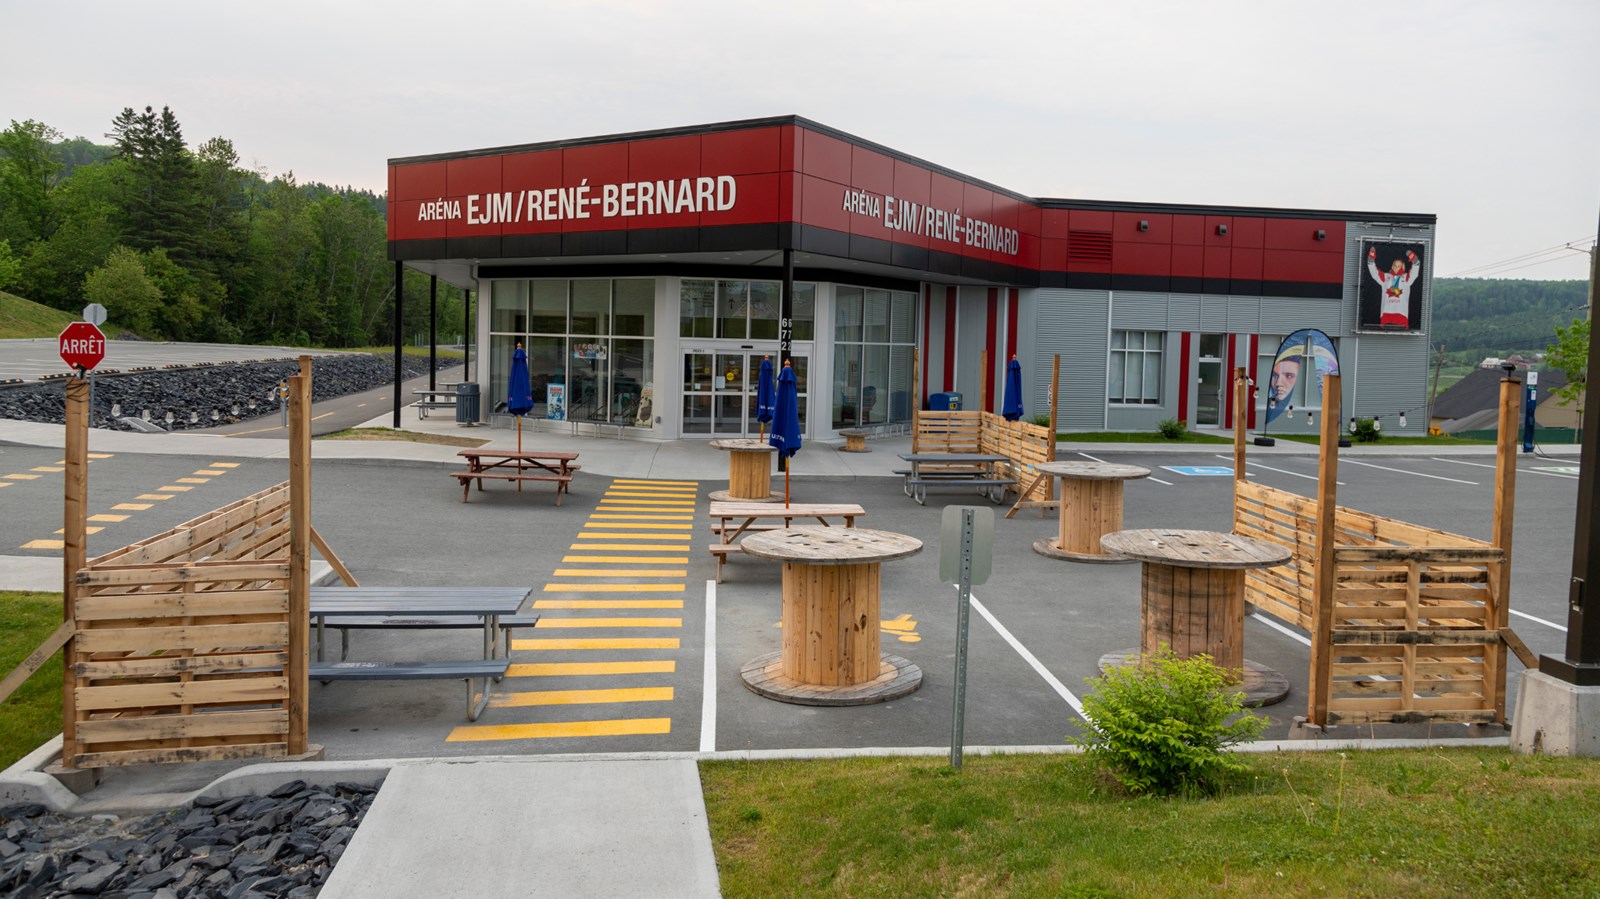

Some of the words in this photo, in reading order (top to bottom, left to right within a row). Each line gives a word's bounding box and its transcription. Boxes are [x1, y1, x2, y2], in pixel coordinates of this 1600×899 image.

[418, 198, 462, 222] ARÉNA
[843, 190, 881, 219] ARÉNA
[61, 335, 104, 355] ARRÊT
